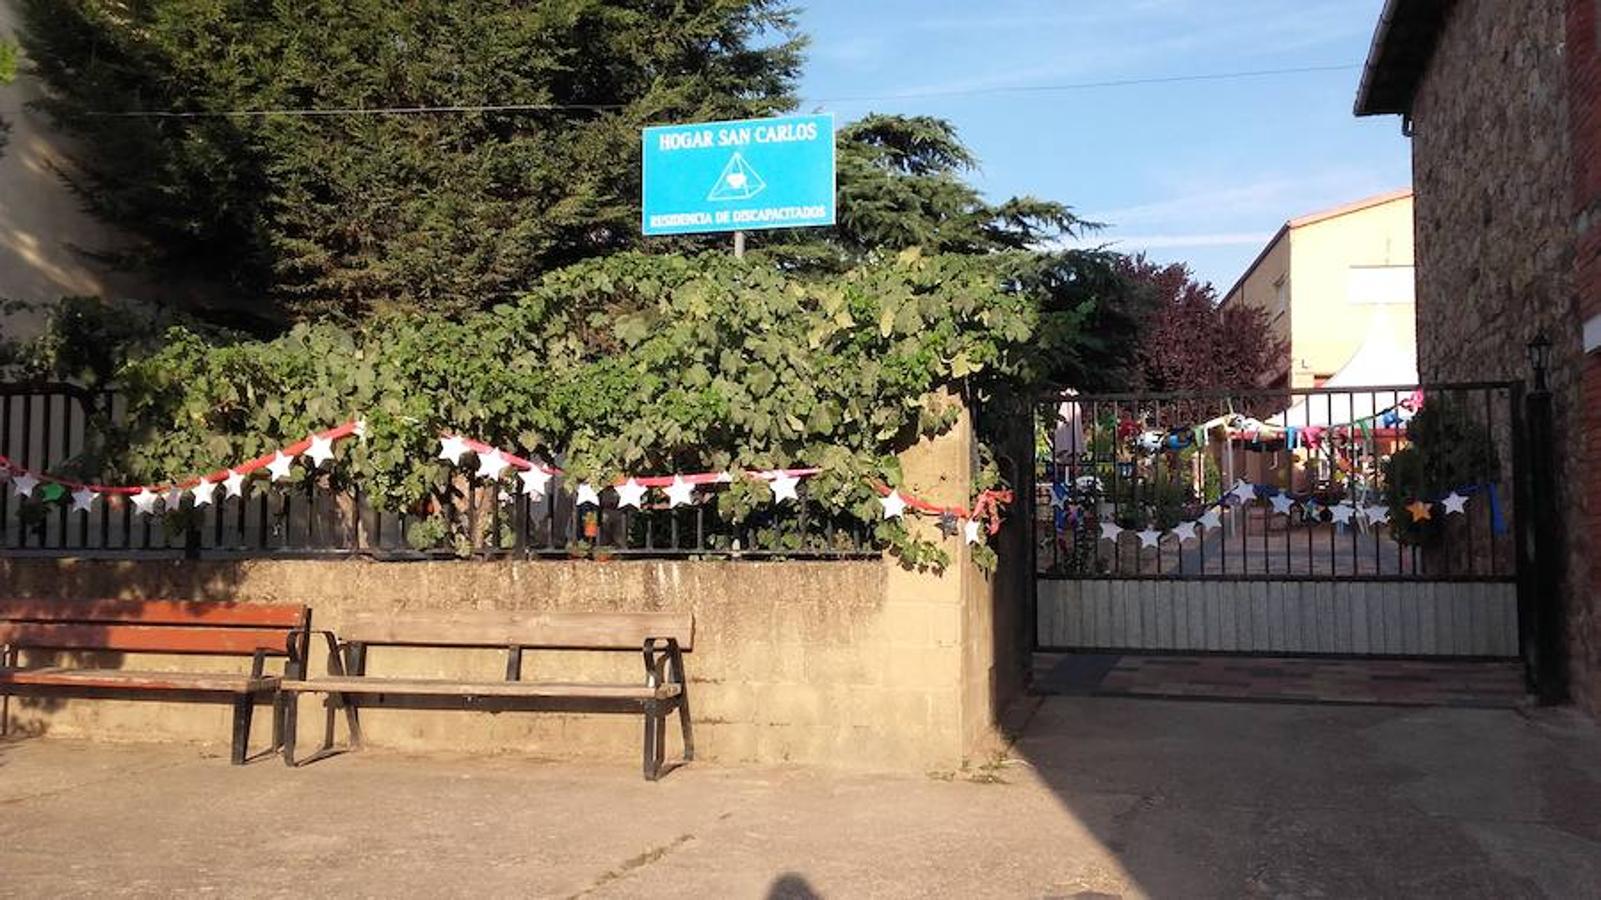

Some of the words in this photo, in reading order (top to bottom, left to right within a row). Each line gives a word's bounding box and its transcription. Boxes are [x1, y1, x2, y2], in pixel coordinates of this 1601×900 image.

[660, 133, 713, 150] HOGAR
[718, 128, 750, 146] SAN
[755, 122, 817, 142] CARLOS
[651, 212, 712, 227] RESIDENCIA
[716, 210, 729, 223] DE
[733, 205, 826, 222] DISCAPACITADOS
